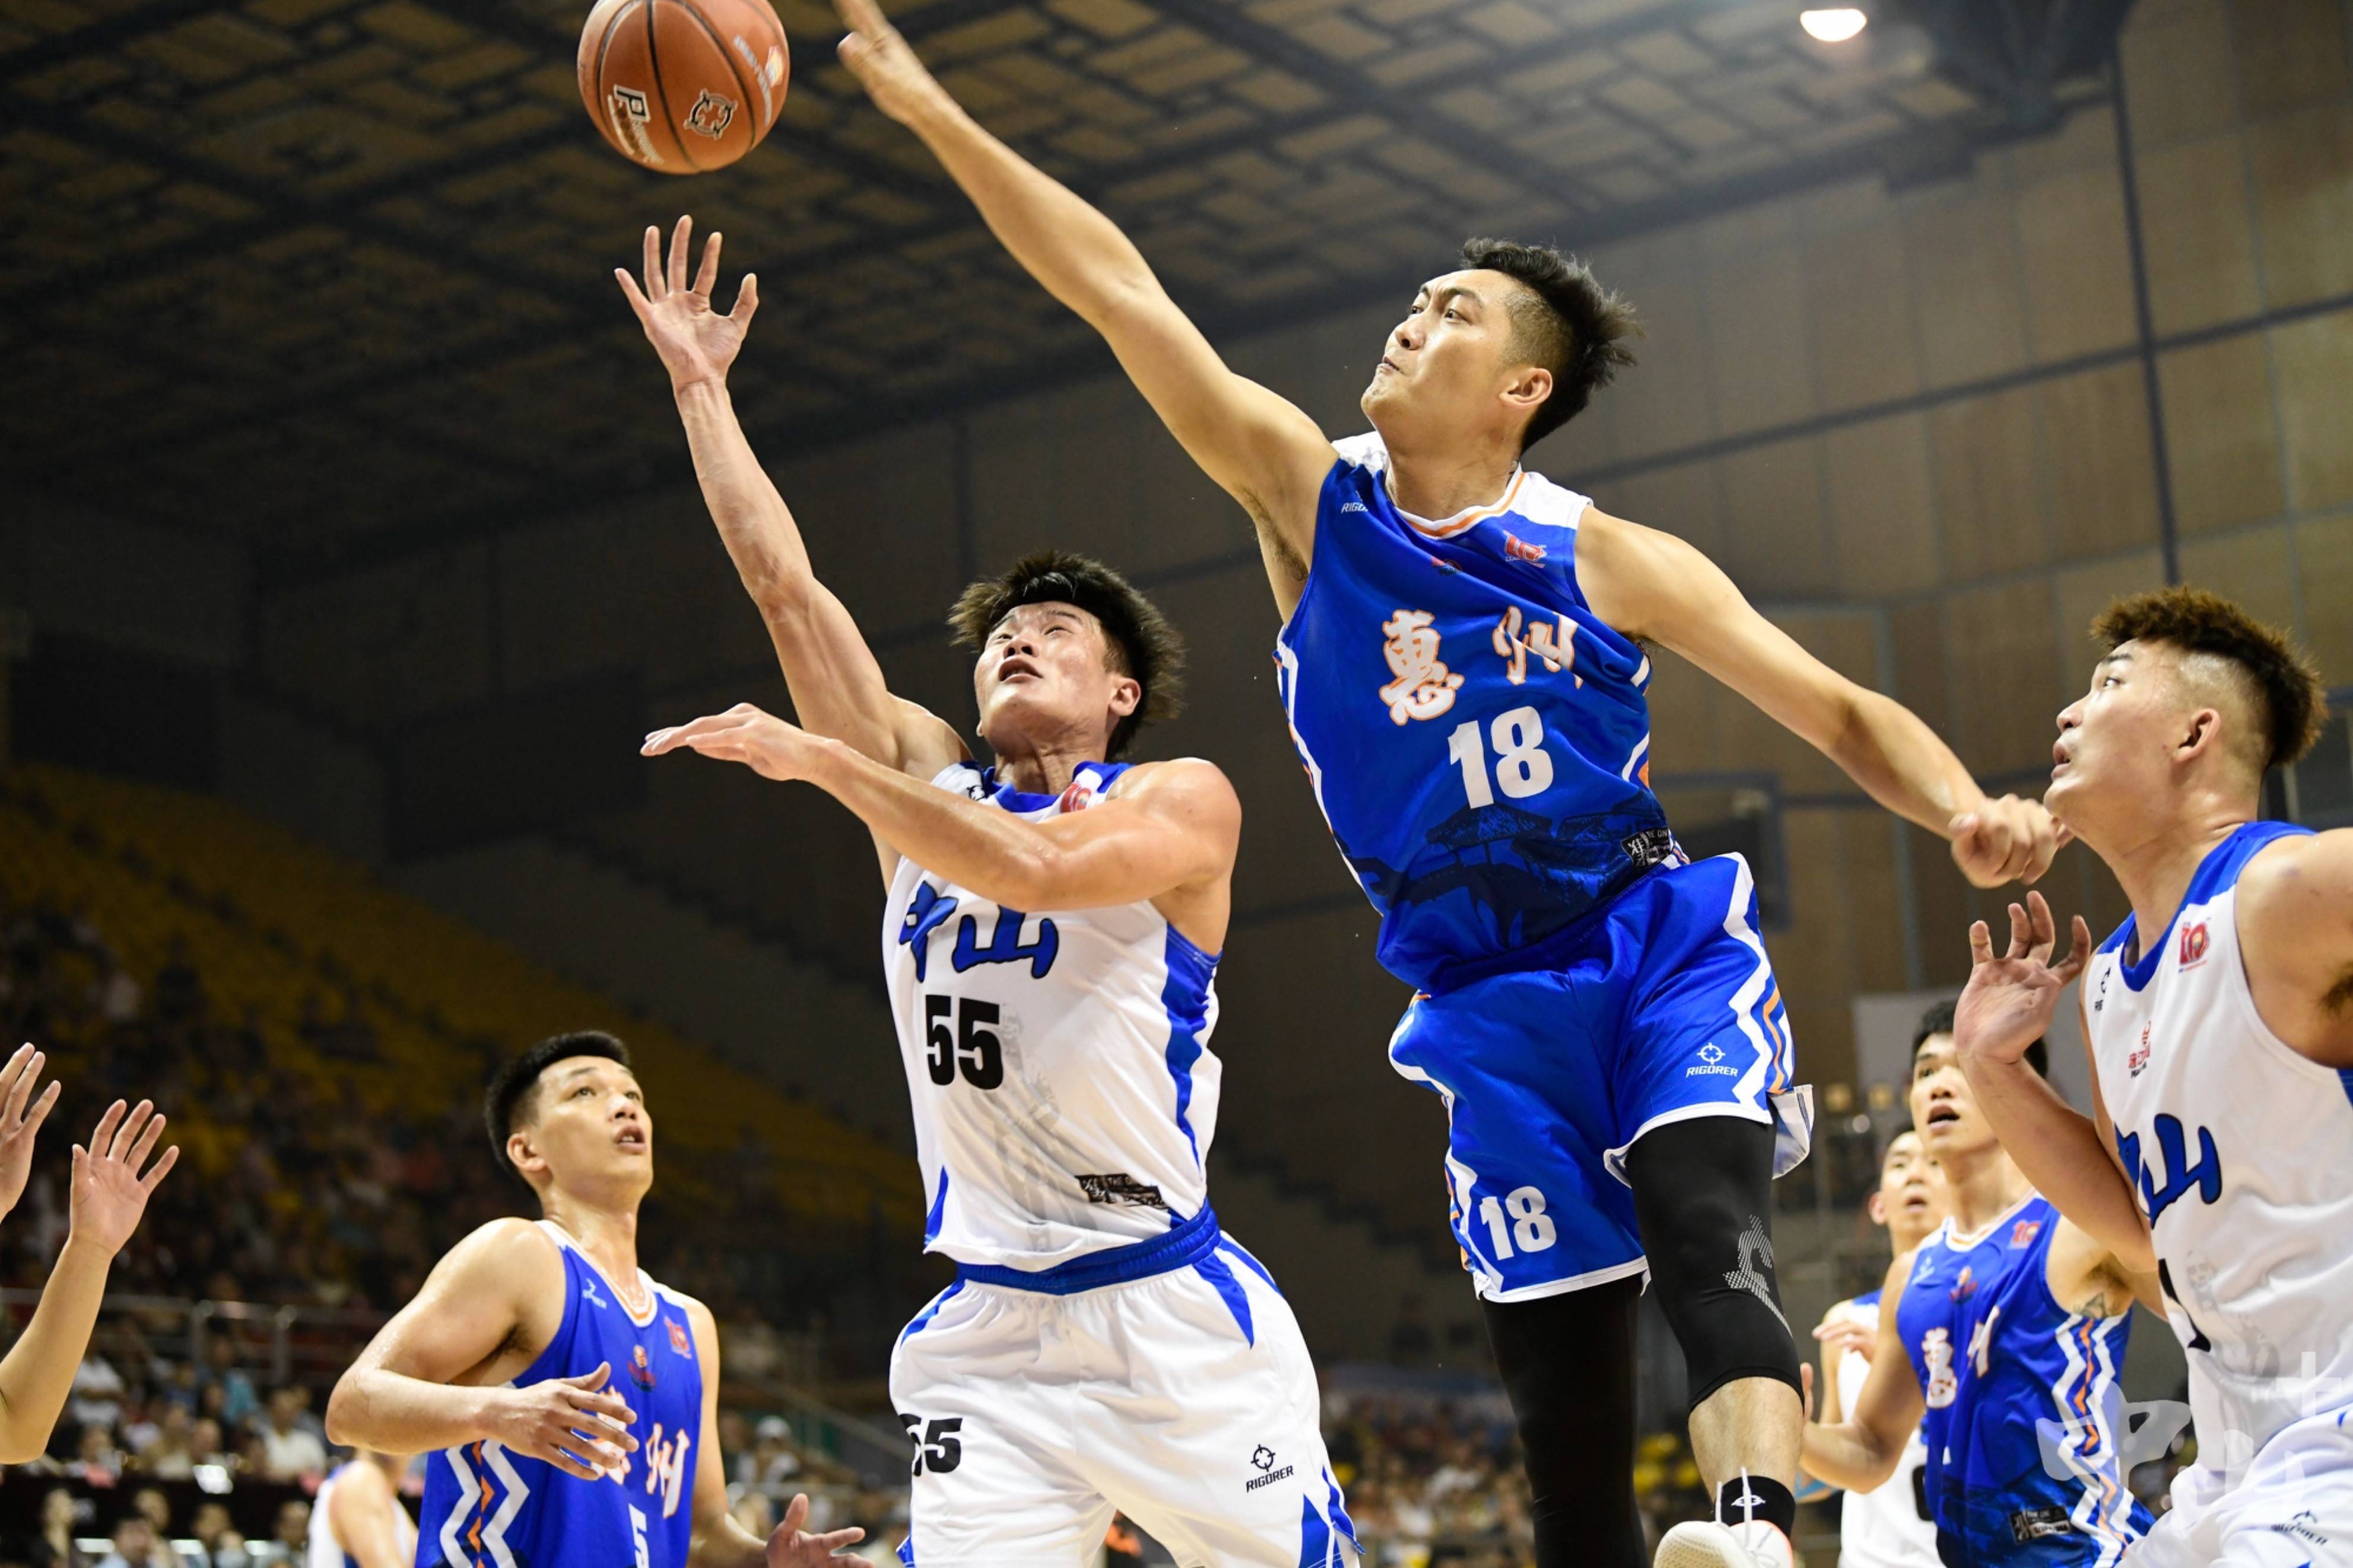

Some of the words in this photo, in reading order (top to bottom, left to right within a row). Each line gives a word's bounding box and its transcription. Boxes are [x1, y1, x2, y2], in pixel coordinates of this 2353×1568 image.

[1341, 502, 1368, 514] RIGO
[1448, 706, 1554, 809] 18
[925, 994, 1004, 1090] 55
[1686, 1066, 1738, 1077] RIGORER
[1479, 1186, 1557, 1260] 18
[1246, 1465, 1294, 1493] RIGORER
